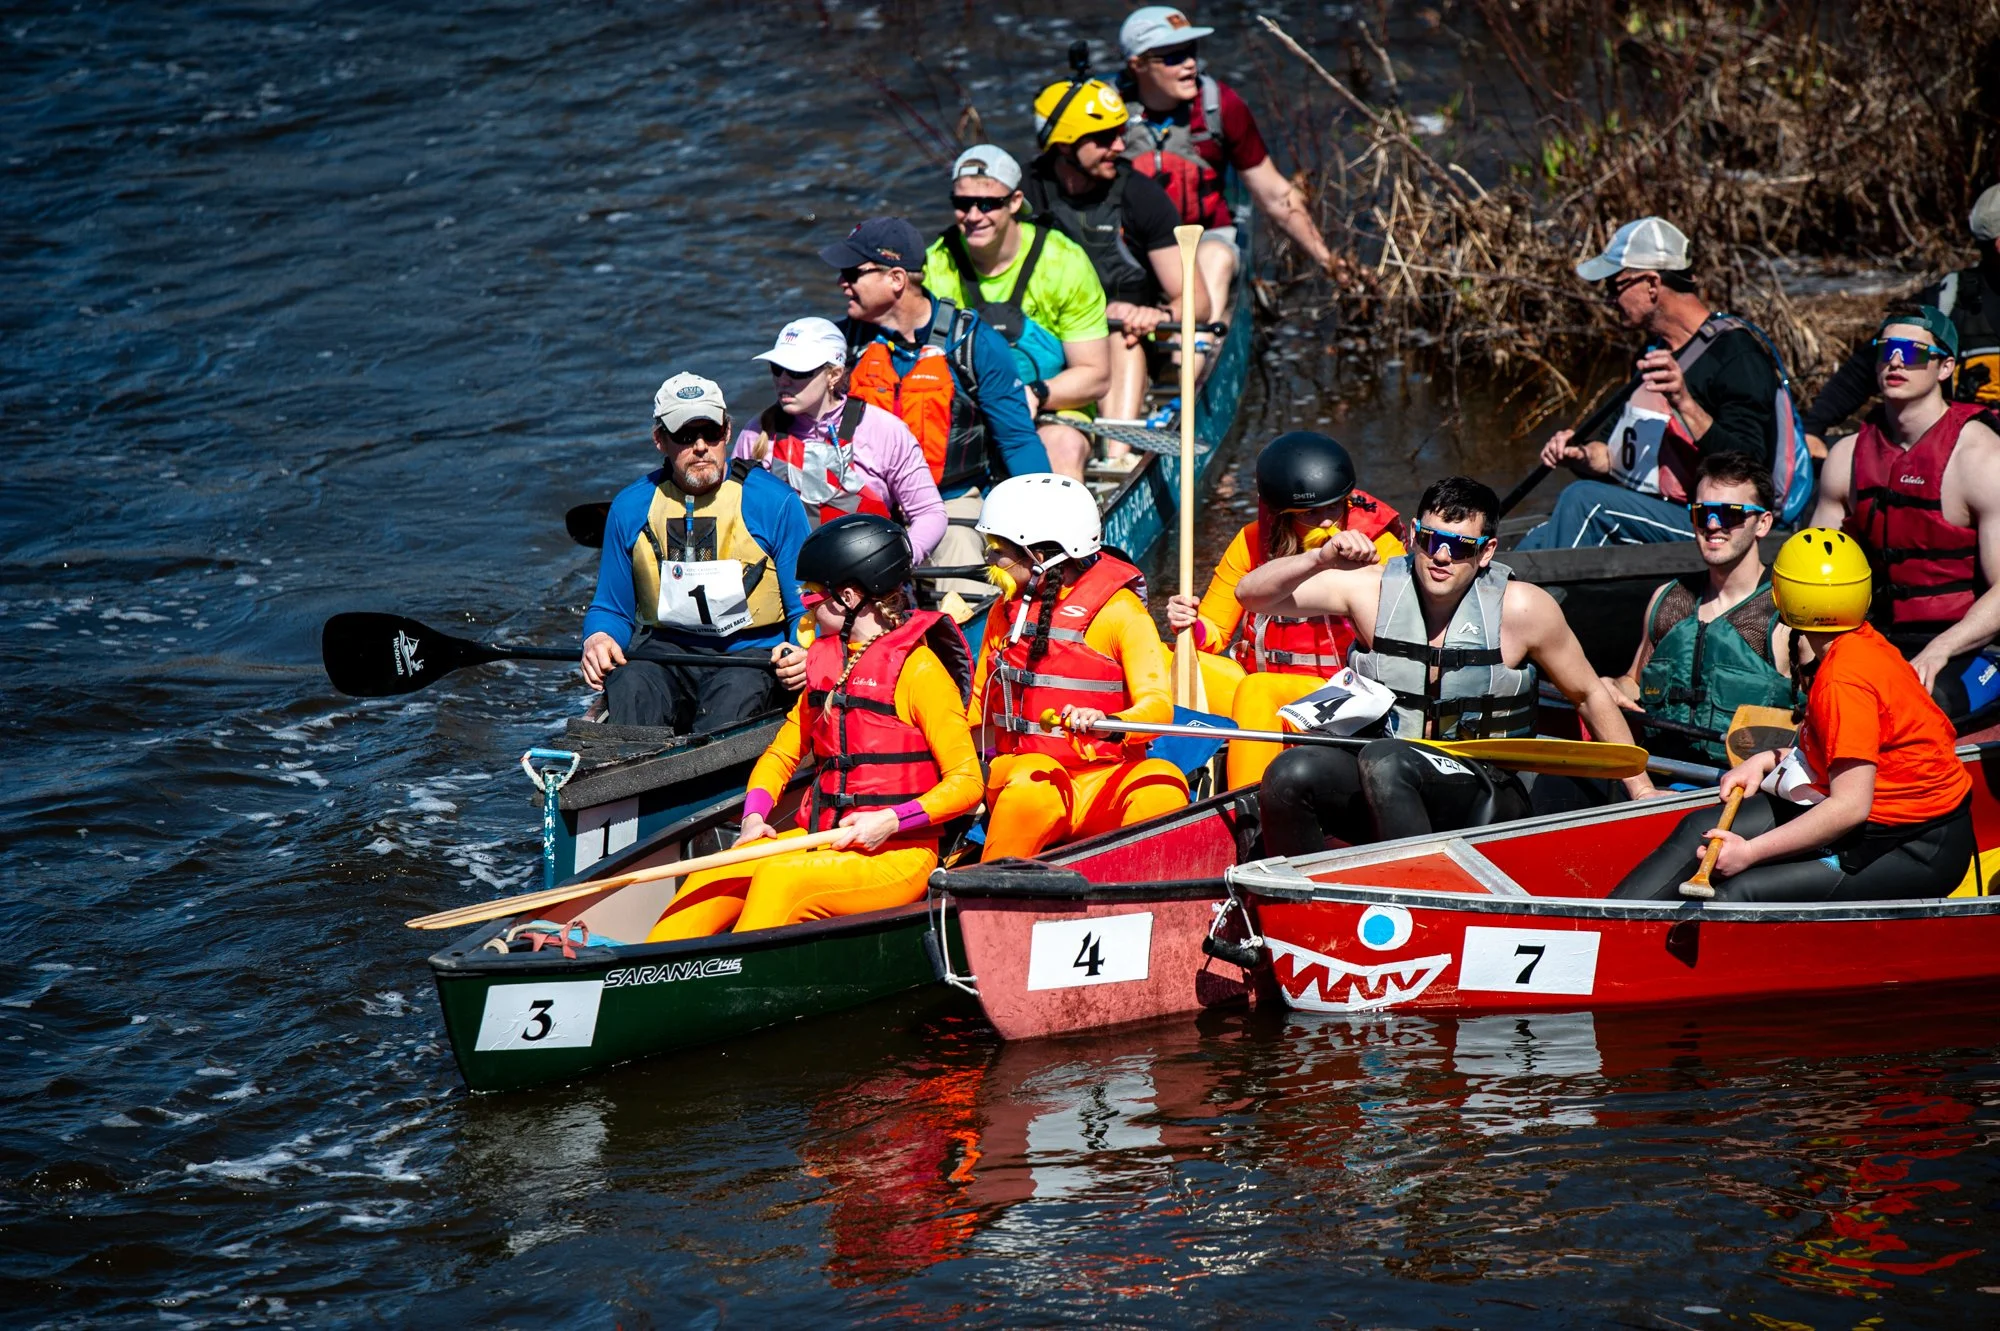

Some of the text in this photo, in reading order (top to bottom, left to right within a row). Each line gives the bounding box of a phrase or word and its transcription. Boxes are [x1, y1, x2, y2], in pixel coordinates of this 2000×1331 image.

[1622, 427, 1638, 472] 6
[1293, 492, 1316, 500] SMITH
[688, 584, 713, 625] 1
[717, 623, 734, 634] CANOE
[733, 617, 746, 627] RACE
[1313, 693, 1357, 724] 4
[598, 817, 612, 860] 1
[603, 957, 743, 989] SARANAC 146
[1072, 930, 1106, 977] 4
[1513, 943, 1546, 985] 7
[520, 999, 555, 1042] 3
